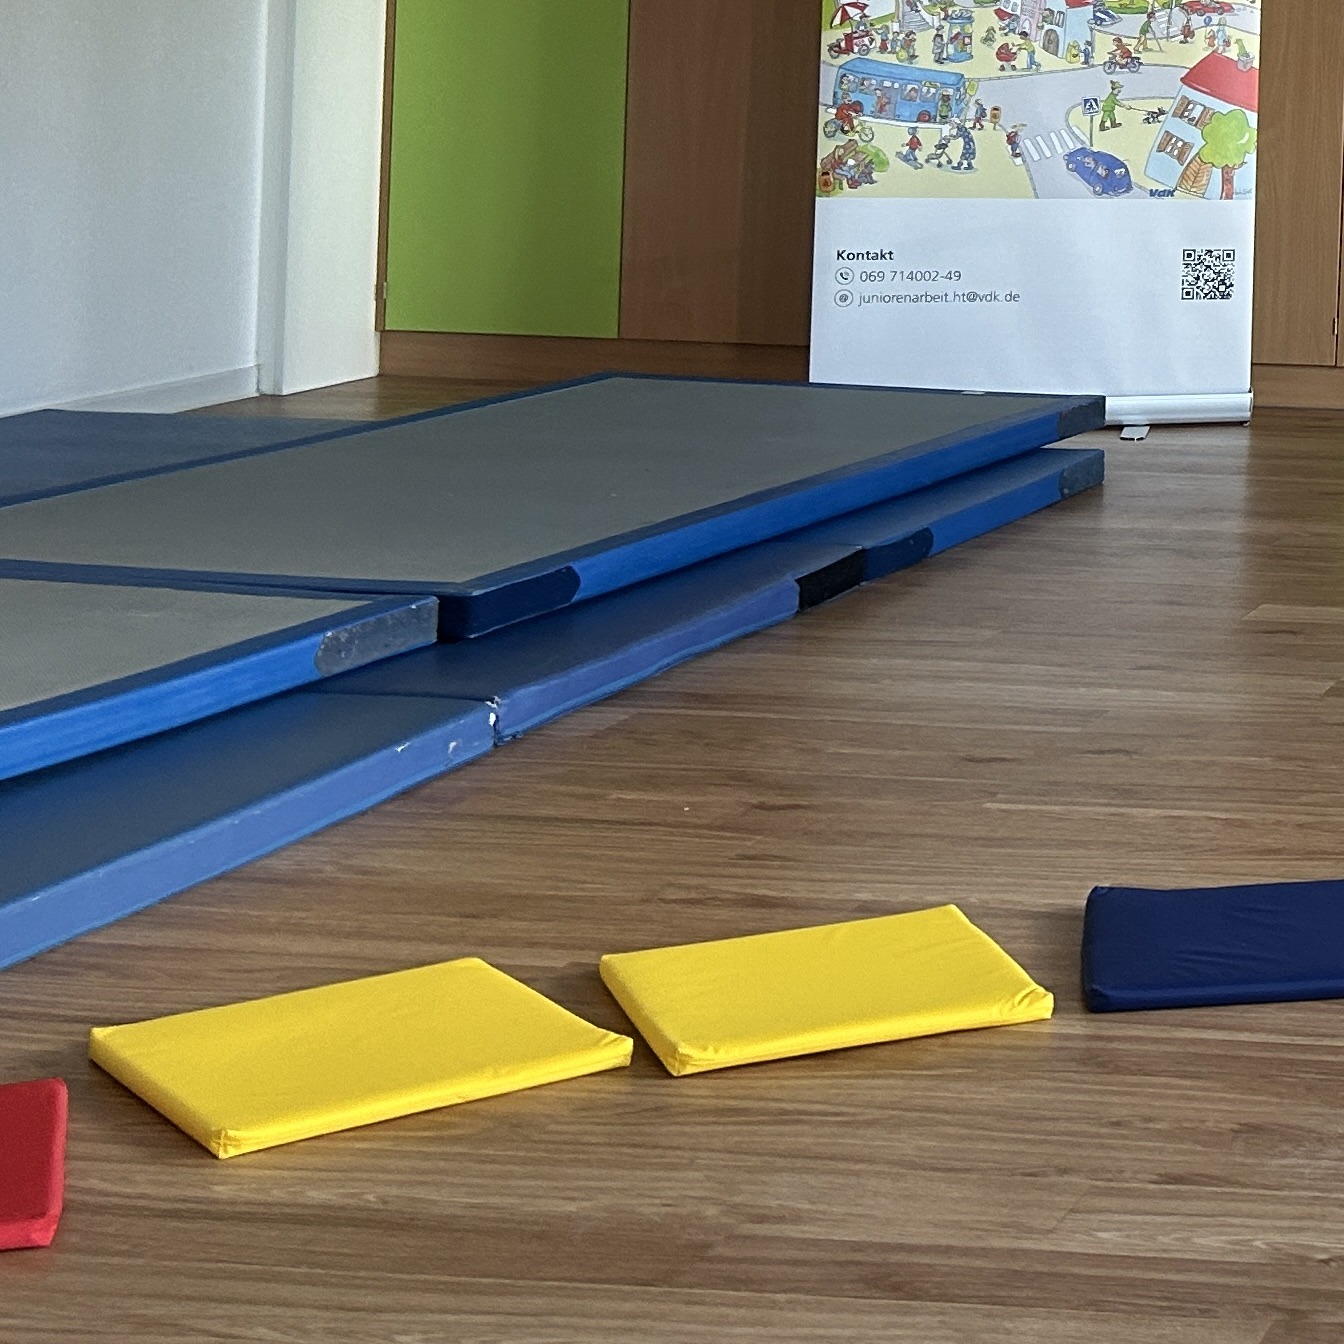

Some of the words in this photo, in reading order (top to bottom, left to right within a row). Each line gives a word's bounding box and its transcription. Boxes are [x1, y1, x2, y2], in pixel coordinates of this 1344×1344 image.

[1149, 188, 1175, 198] VdK
[836, 249, 895, 261] Kontakt
[859, 270, 885, 283] 069
[890, 270, 962, 283] 714002-49
[858, 290, 1021, 307] juniorenarbeit.ht@vdk.de
